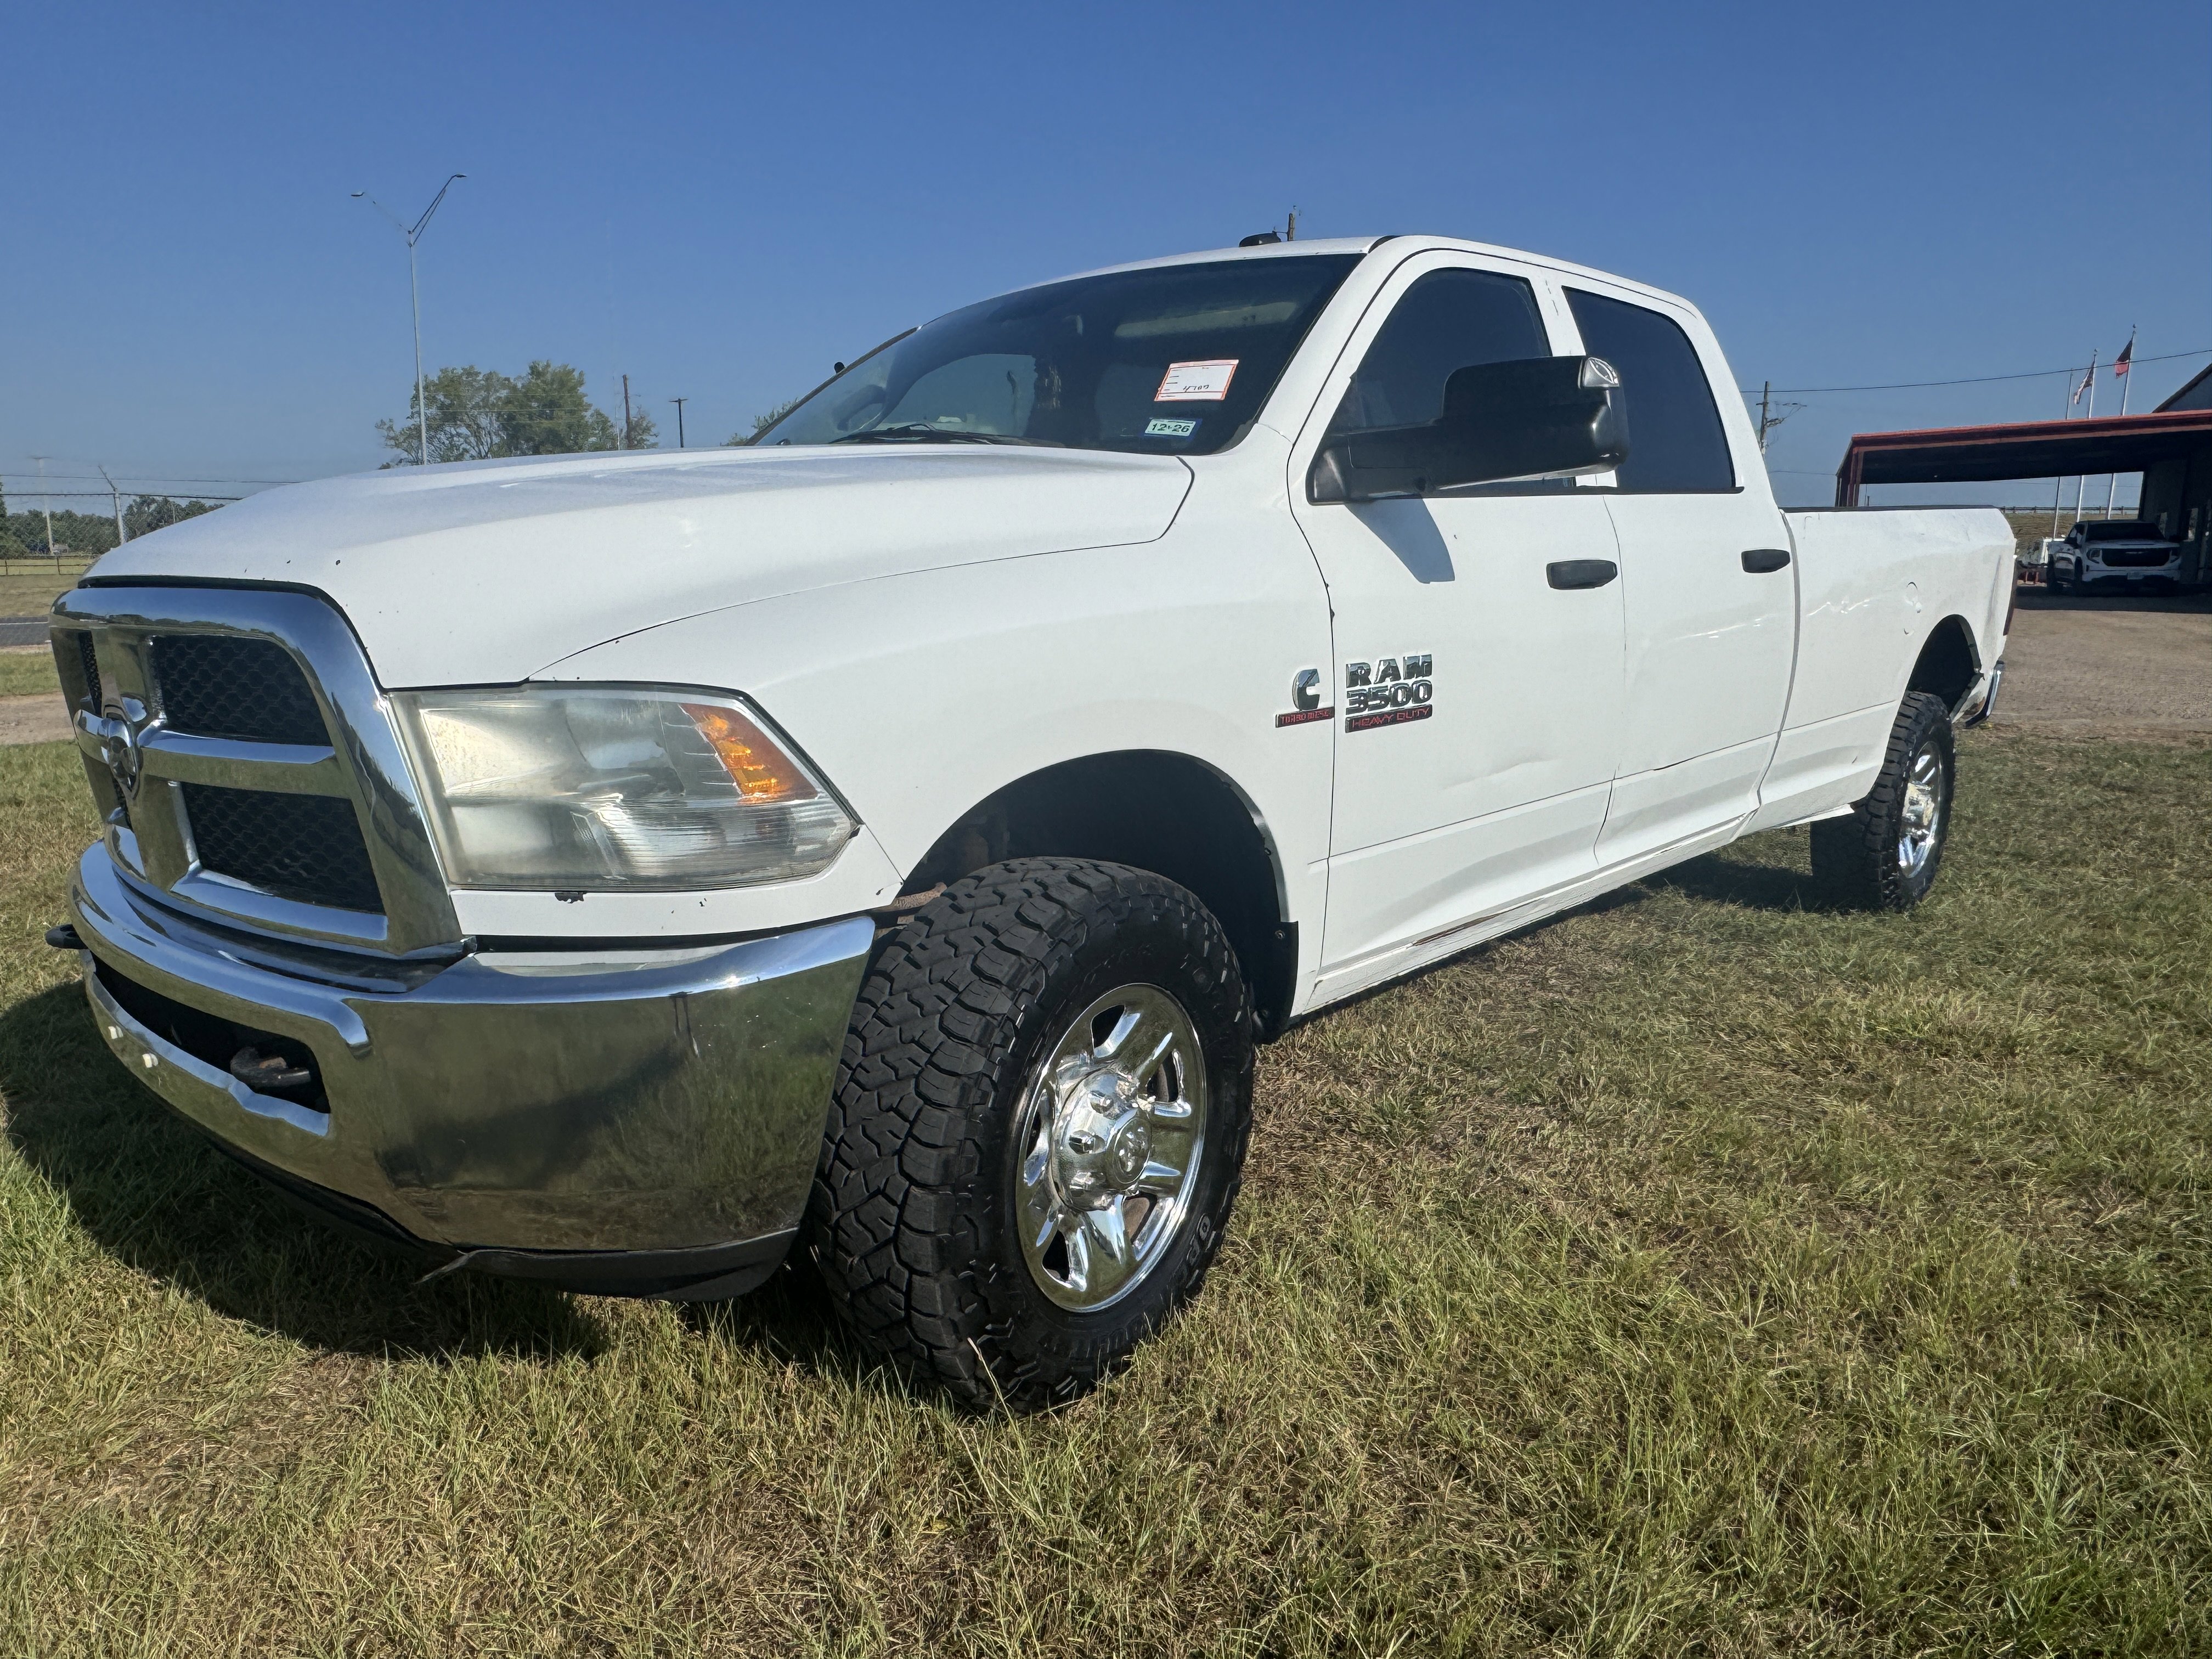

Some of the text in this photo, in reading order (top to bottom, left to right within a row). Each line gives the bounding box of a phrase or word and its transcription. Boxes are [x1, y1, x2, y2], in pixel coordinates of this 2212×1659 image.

[1346, 654, 1432, 688] RAM
[1346, 680, 1432, 715] 3500
[1352, 708, 1430, 729] HEAVY DUTY
